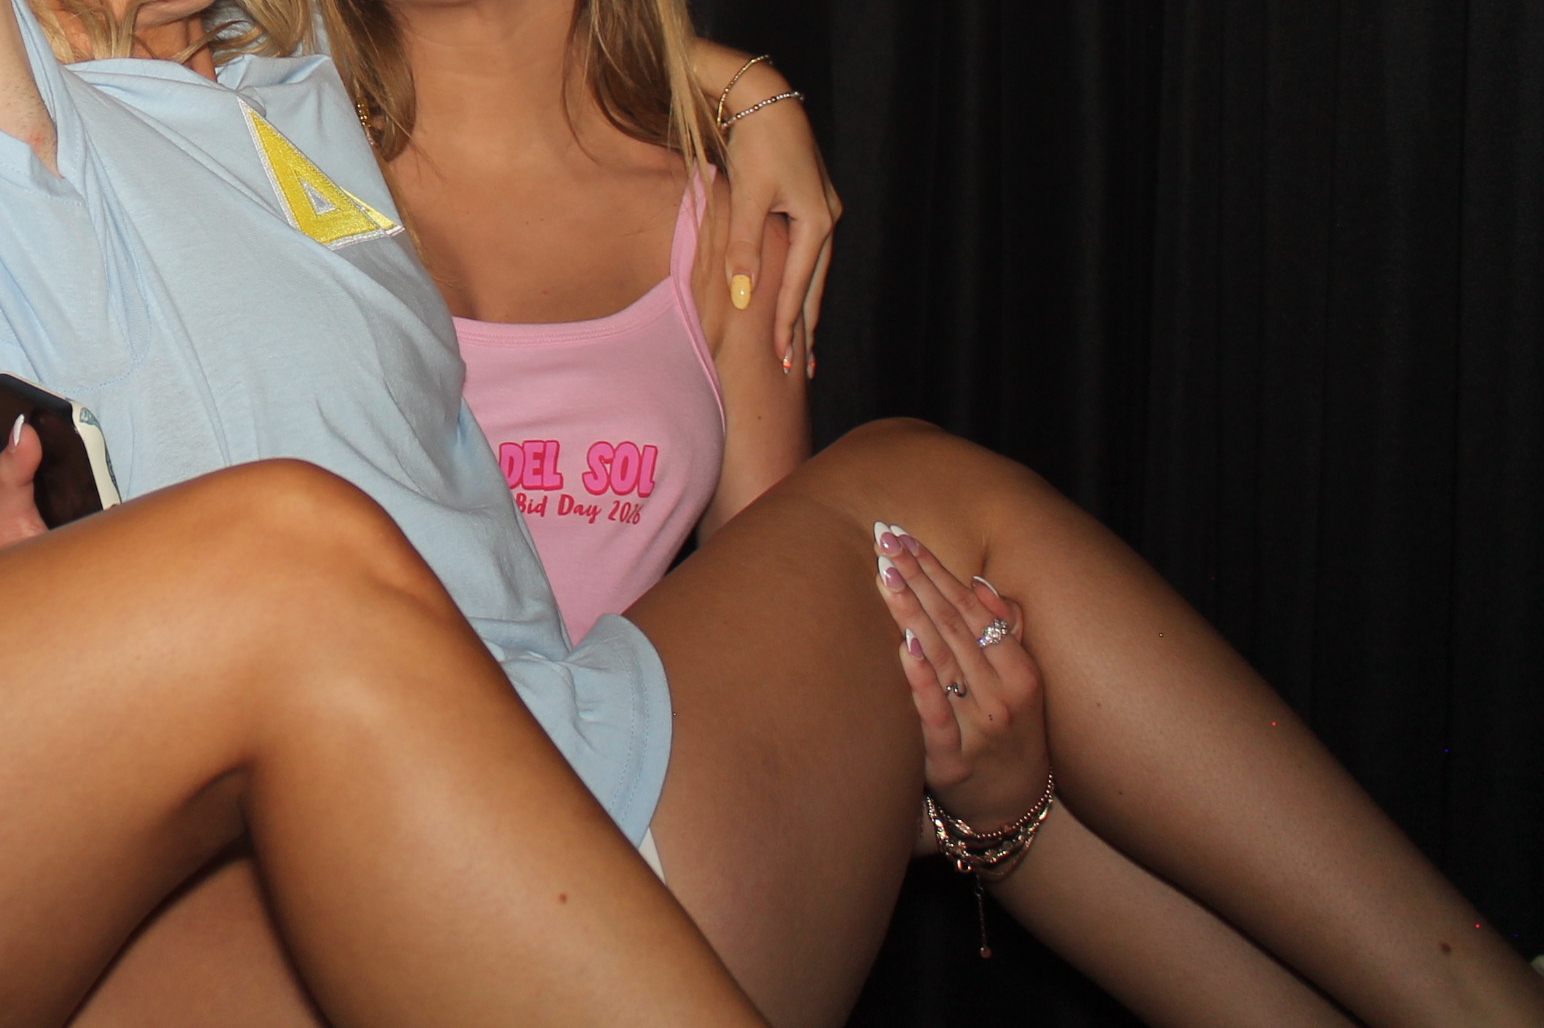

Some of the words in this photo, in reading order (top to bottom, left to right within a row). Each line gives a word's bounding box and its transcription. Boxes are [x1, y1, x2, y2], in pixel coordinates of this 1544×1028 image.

[499, 440, 563, 490] DEL
[516, 493, 548, 517] Bid
[557, 494, 602, 524] Day
